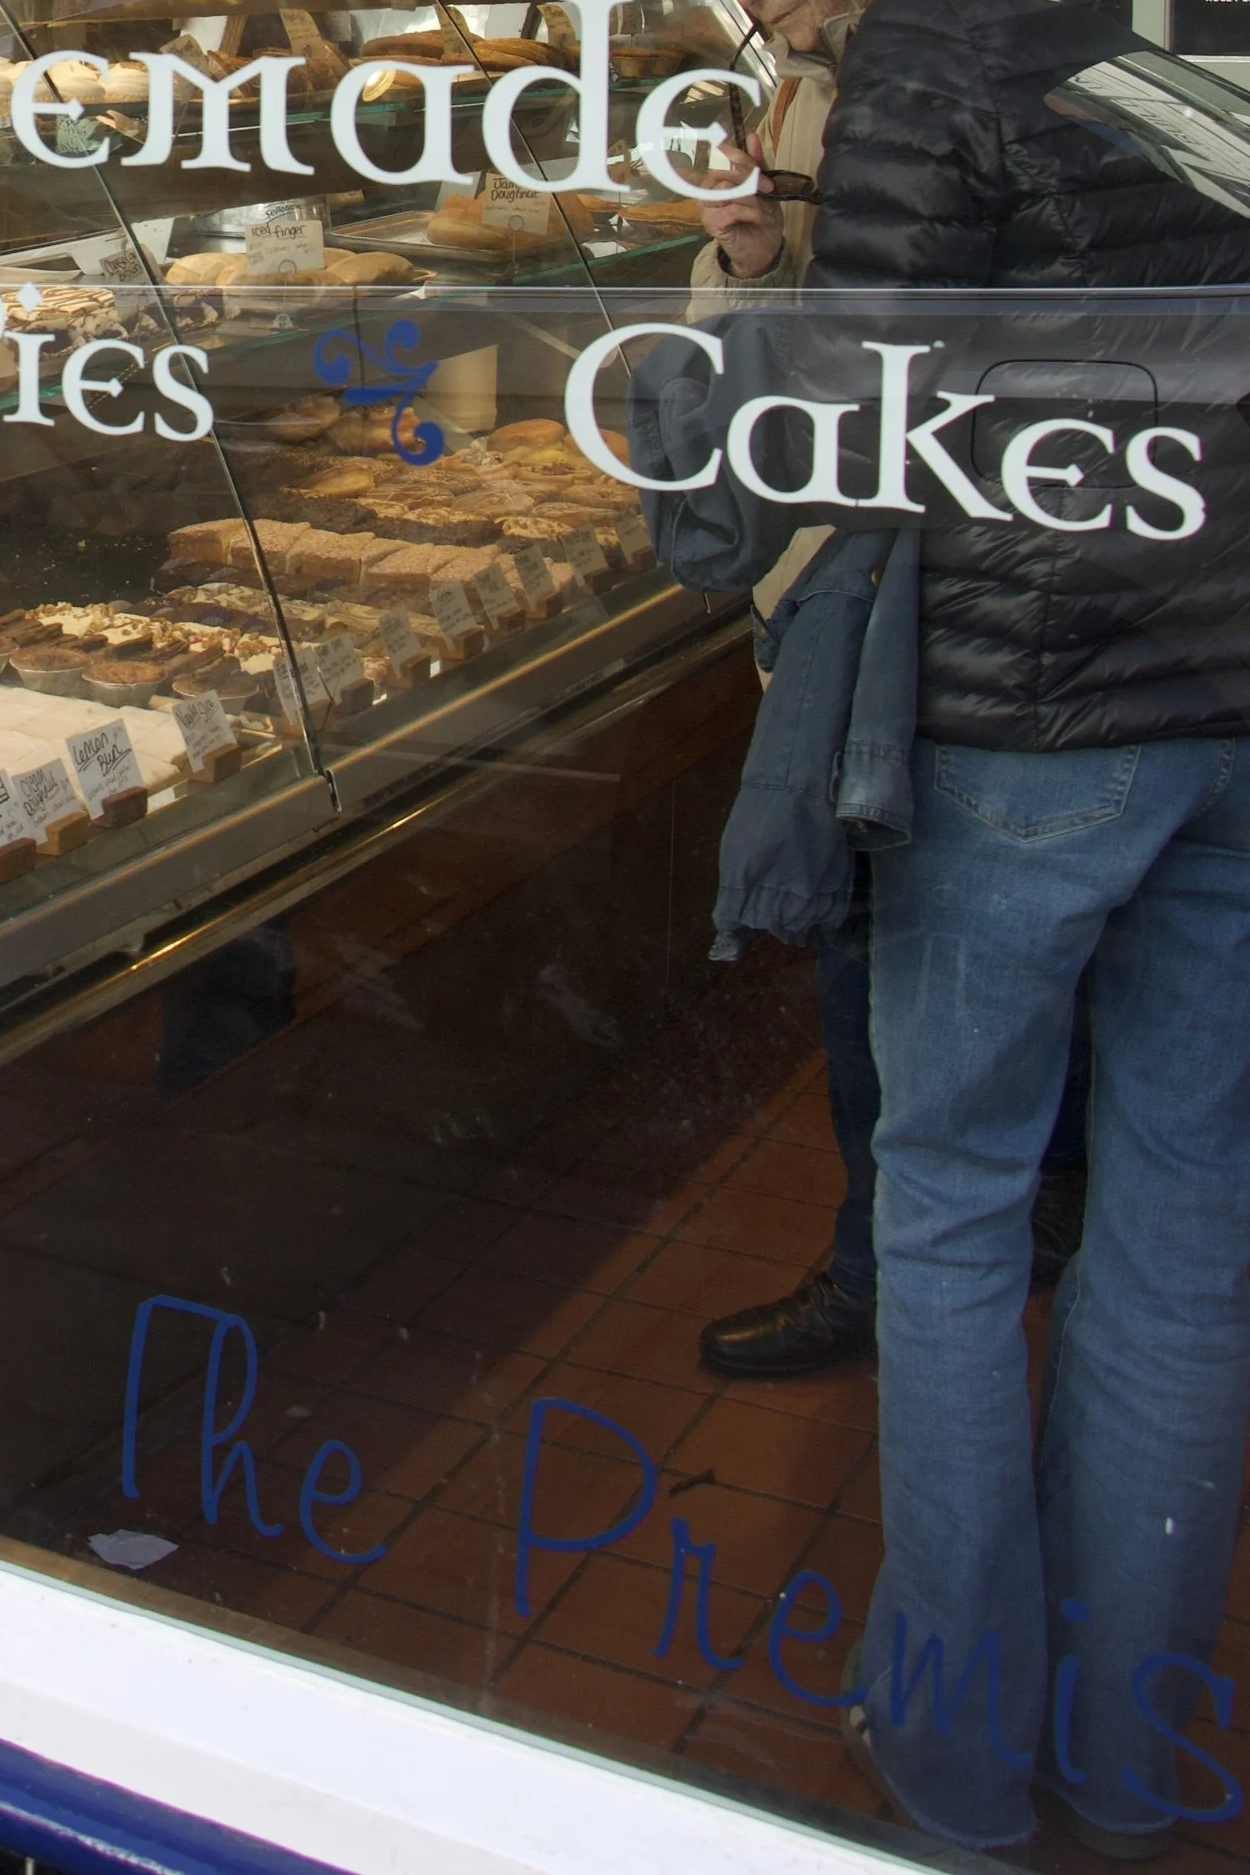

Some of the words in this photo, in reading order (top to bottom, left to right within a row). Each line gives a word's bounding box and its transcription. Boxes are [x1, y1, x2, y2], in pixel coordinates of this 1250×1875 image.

[563, 322, 1206, 541] Cakes
[72, 732, 110, 766] Lemon
[121, 1293, 387, 1564] The
[513, 1397, 1244, 1823] Premis
